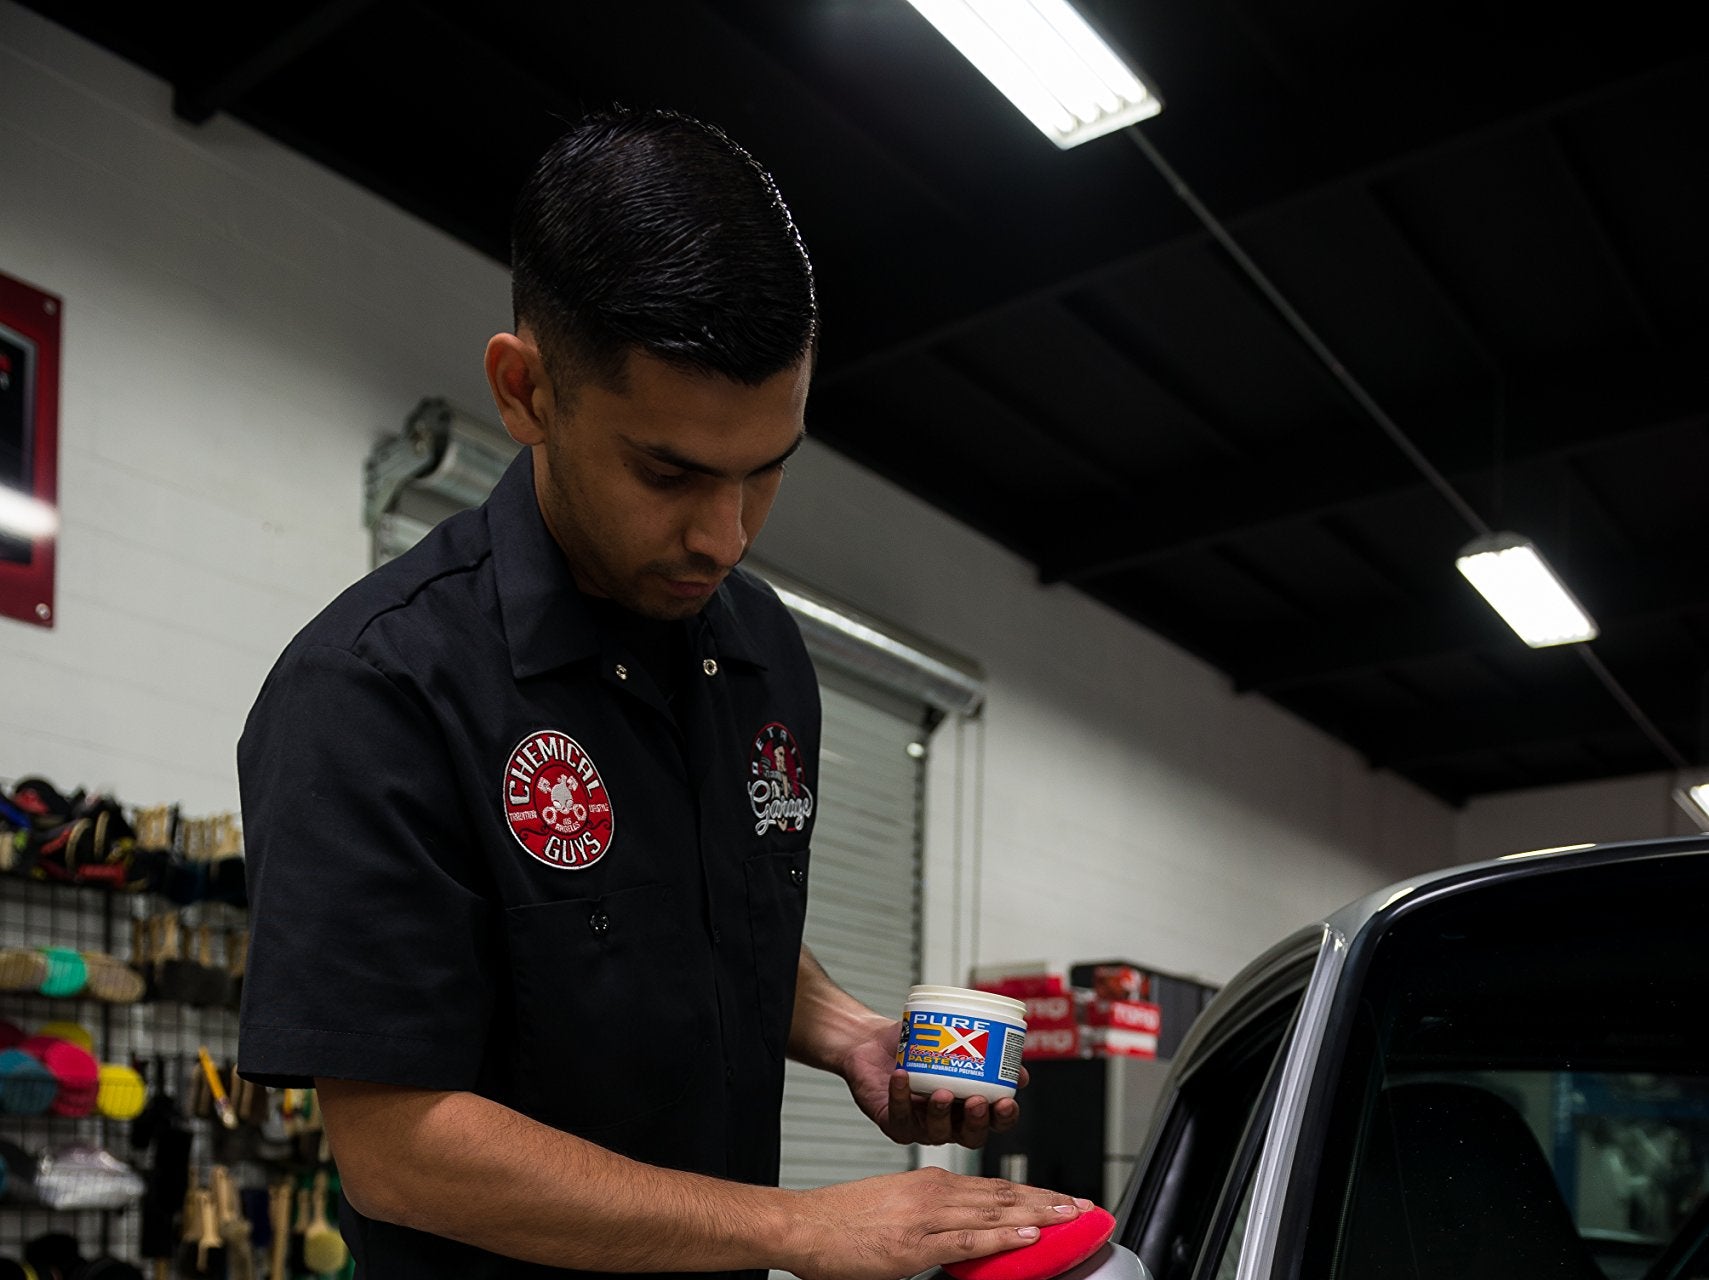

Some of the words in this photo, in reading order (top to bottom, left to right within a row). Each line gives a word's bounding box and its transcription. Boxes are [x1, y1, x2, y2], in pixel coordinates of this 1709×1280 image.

[509, 736, 600, 805] CHEMICAL
[747, 780, 813, 835] Garage
[544, 831, 601, 863] GUYS
[914, 1013, 991, 1033] PURE
